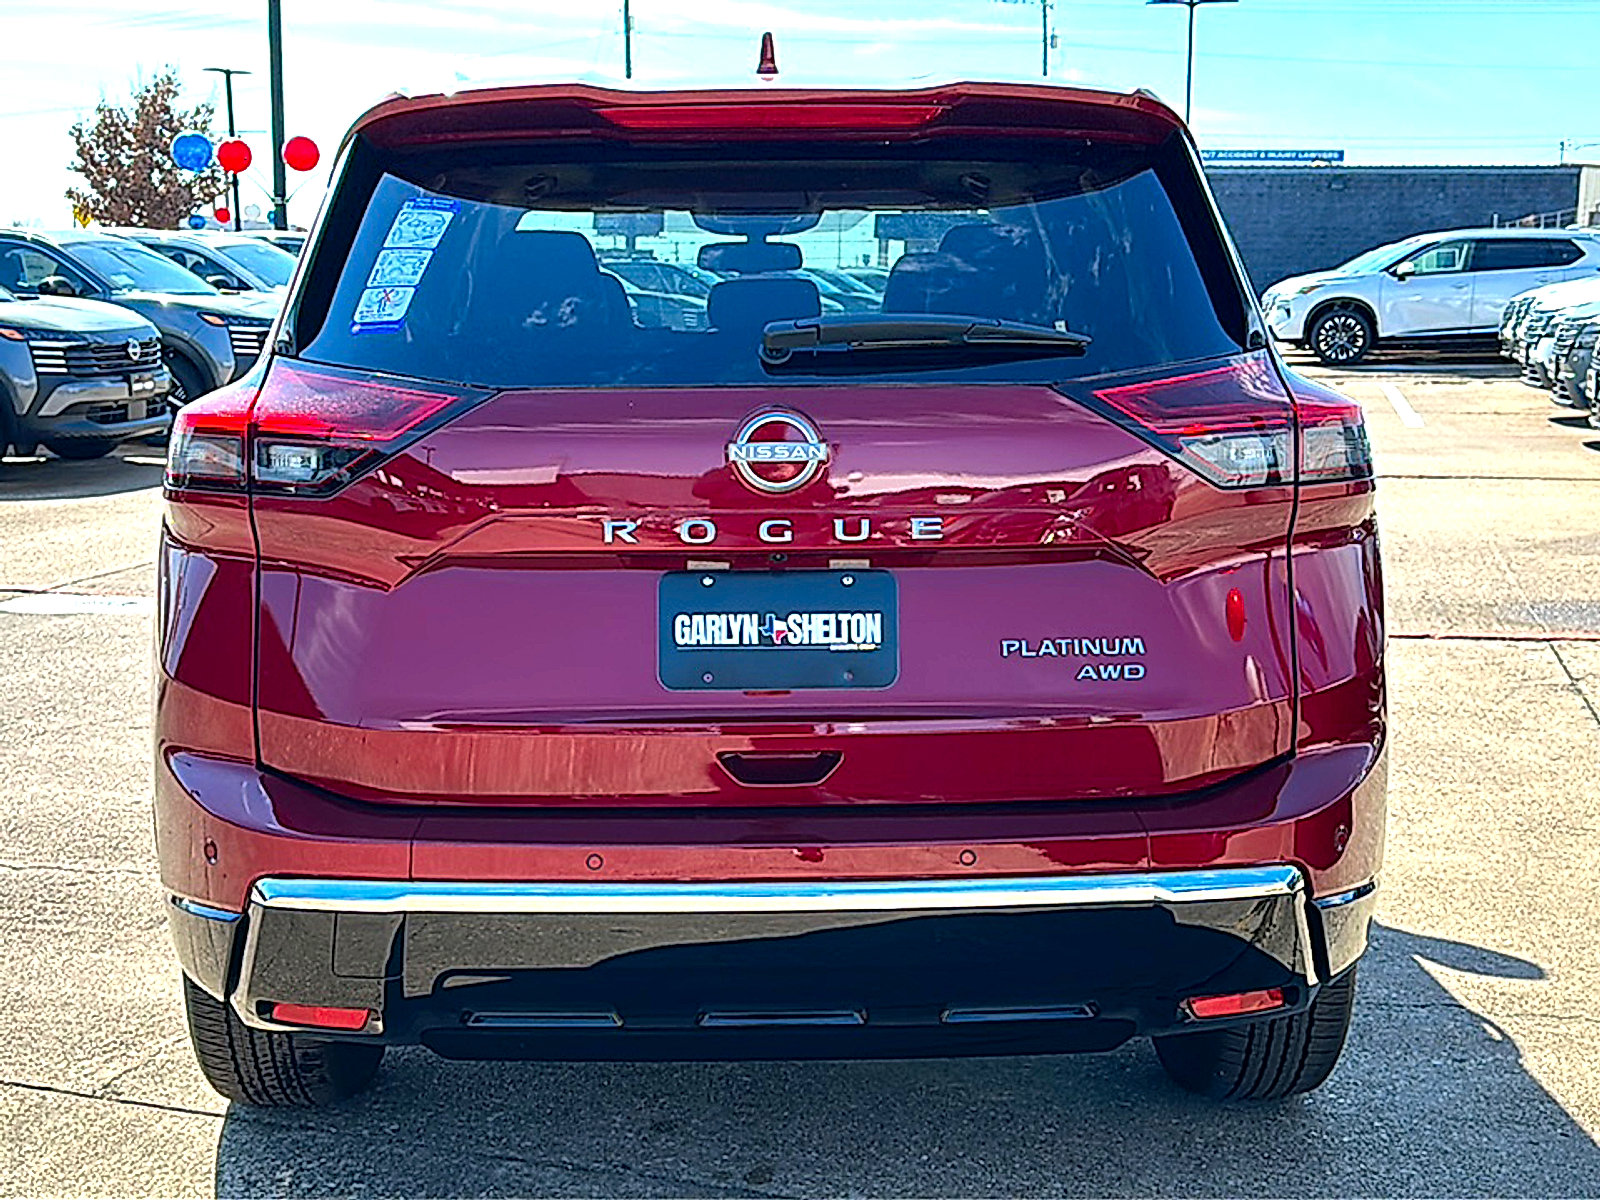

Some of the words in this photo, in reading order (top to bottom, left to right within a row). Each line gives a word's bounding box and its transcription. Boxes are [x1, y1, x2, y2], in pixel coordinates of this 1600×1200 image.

[1217, 151, 1258, 159] ACCIDENT
[1267, 151, 1297, 159] INJURY
[1298, 151, 1339, 159] LAWYERS
[730, 444, 827, 460] NISSAN
[603, 517, 944, 544] ROGUE
[674, 613, 759, 645] GARLYN
[786, 612, 882, 644] SHELTON
[1001, 637, 1146, 657] PLATINUM
[1076, 664, 1145, 680] AWD
